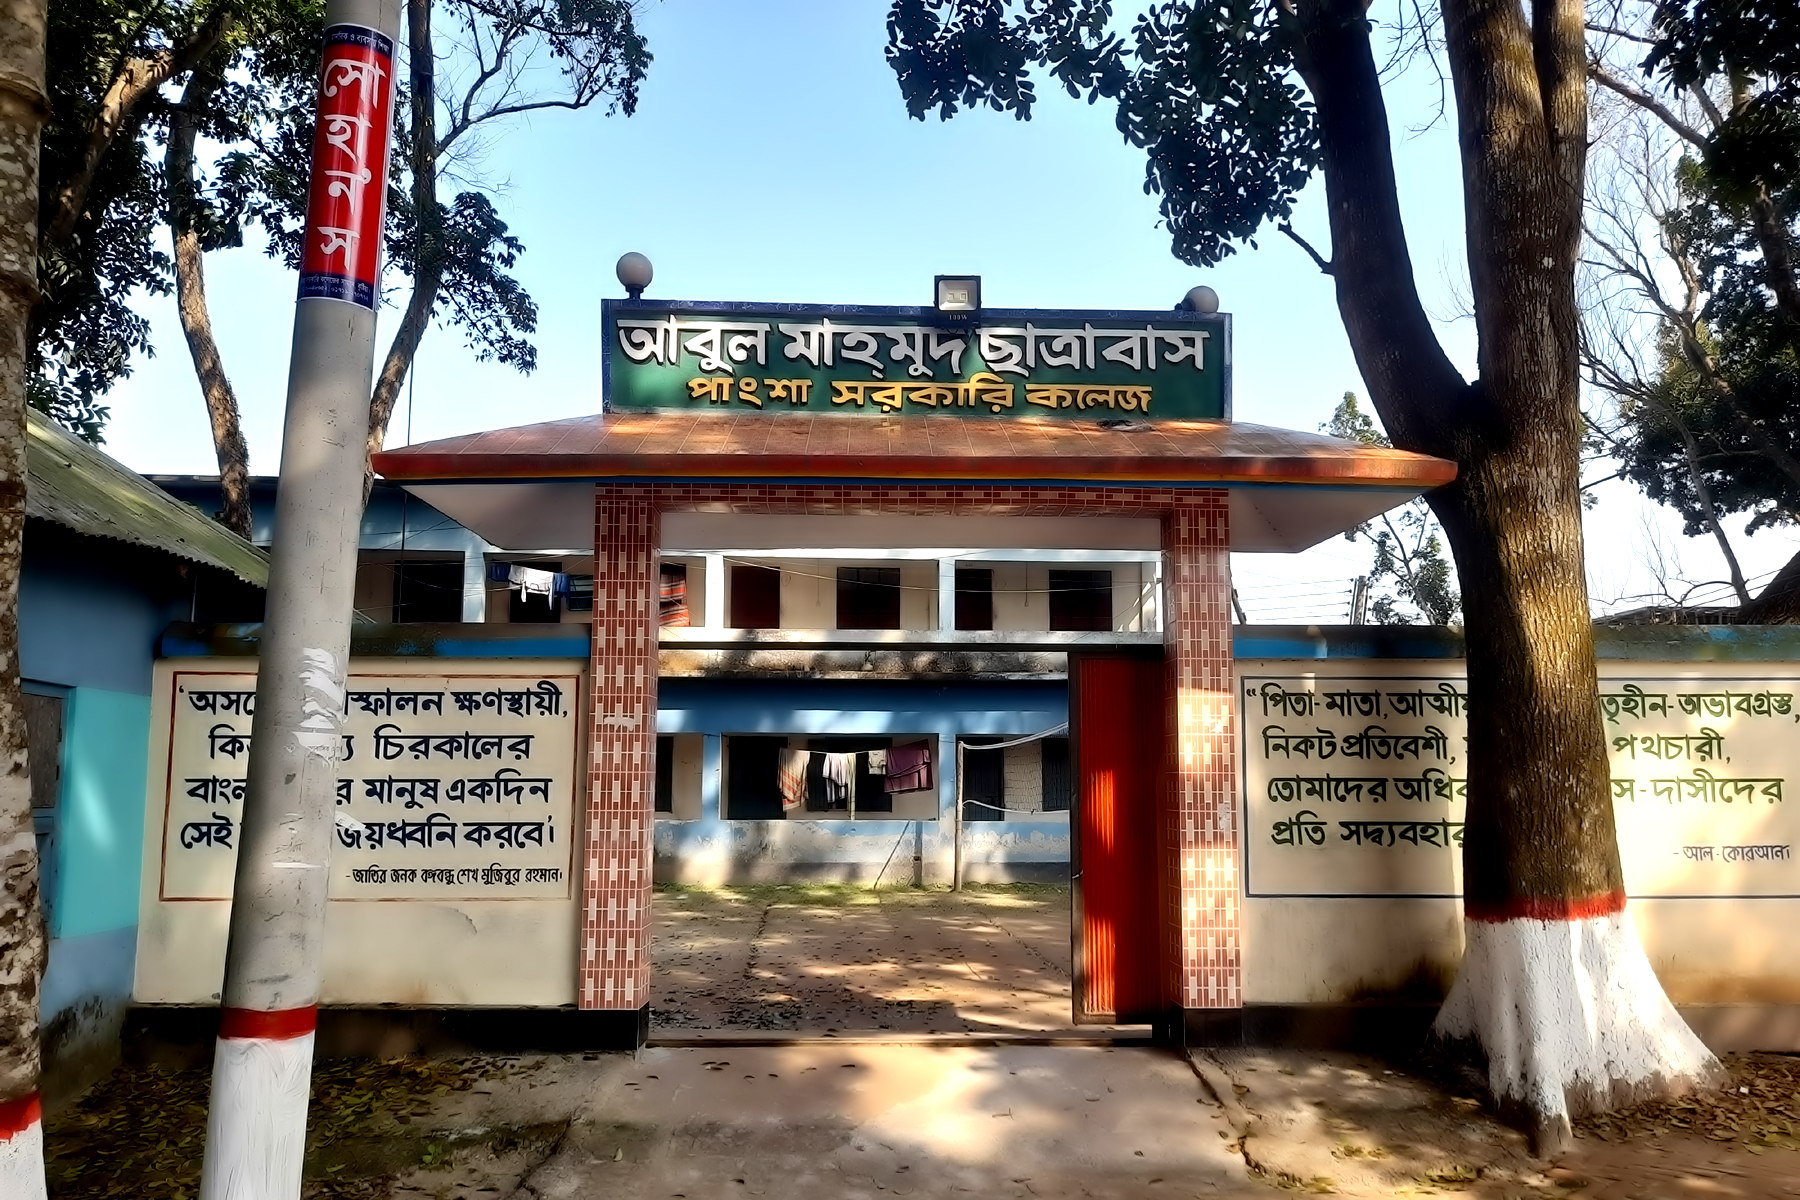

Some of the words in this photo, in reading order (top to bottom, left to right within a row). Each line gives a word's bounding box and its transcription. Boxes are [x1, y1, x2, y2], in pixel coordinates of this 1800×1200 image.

[616, 314, 772, 375] আবুল
[976, 322, 1211, 378] ছাত্রাবাস
[686, 377, 813, 408] পাংশা
[831, 373, 1015, 413] সরকারি
[1025, 383, 1153, 414] কলেজ
[344, 687, 446, 717] স্ফালন
[1386, 683, 1469, 718] আত্মী
[373, 724, 535, 761] চিরকালের
[1262, 724, 1338, 760] নিকট
[1340, 724, 1457, 766] প্রতিবেশী,
[1612, 726, 1731, 764] পথচারী,
[362, 775, 441, 810] মানুষ
[445, 767, 553, 806] একদিন
[1267, 772, 1389, 804] তোমাদের
[180, 811, 234, 850] সেই
[1270, 809, 1328, 847] প্রতি
[390, 868, 418, 884] জনক
[456, 868, 480, 885] শেখ
[480, 862, 522, 887] মুজিবুর
